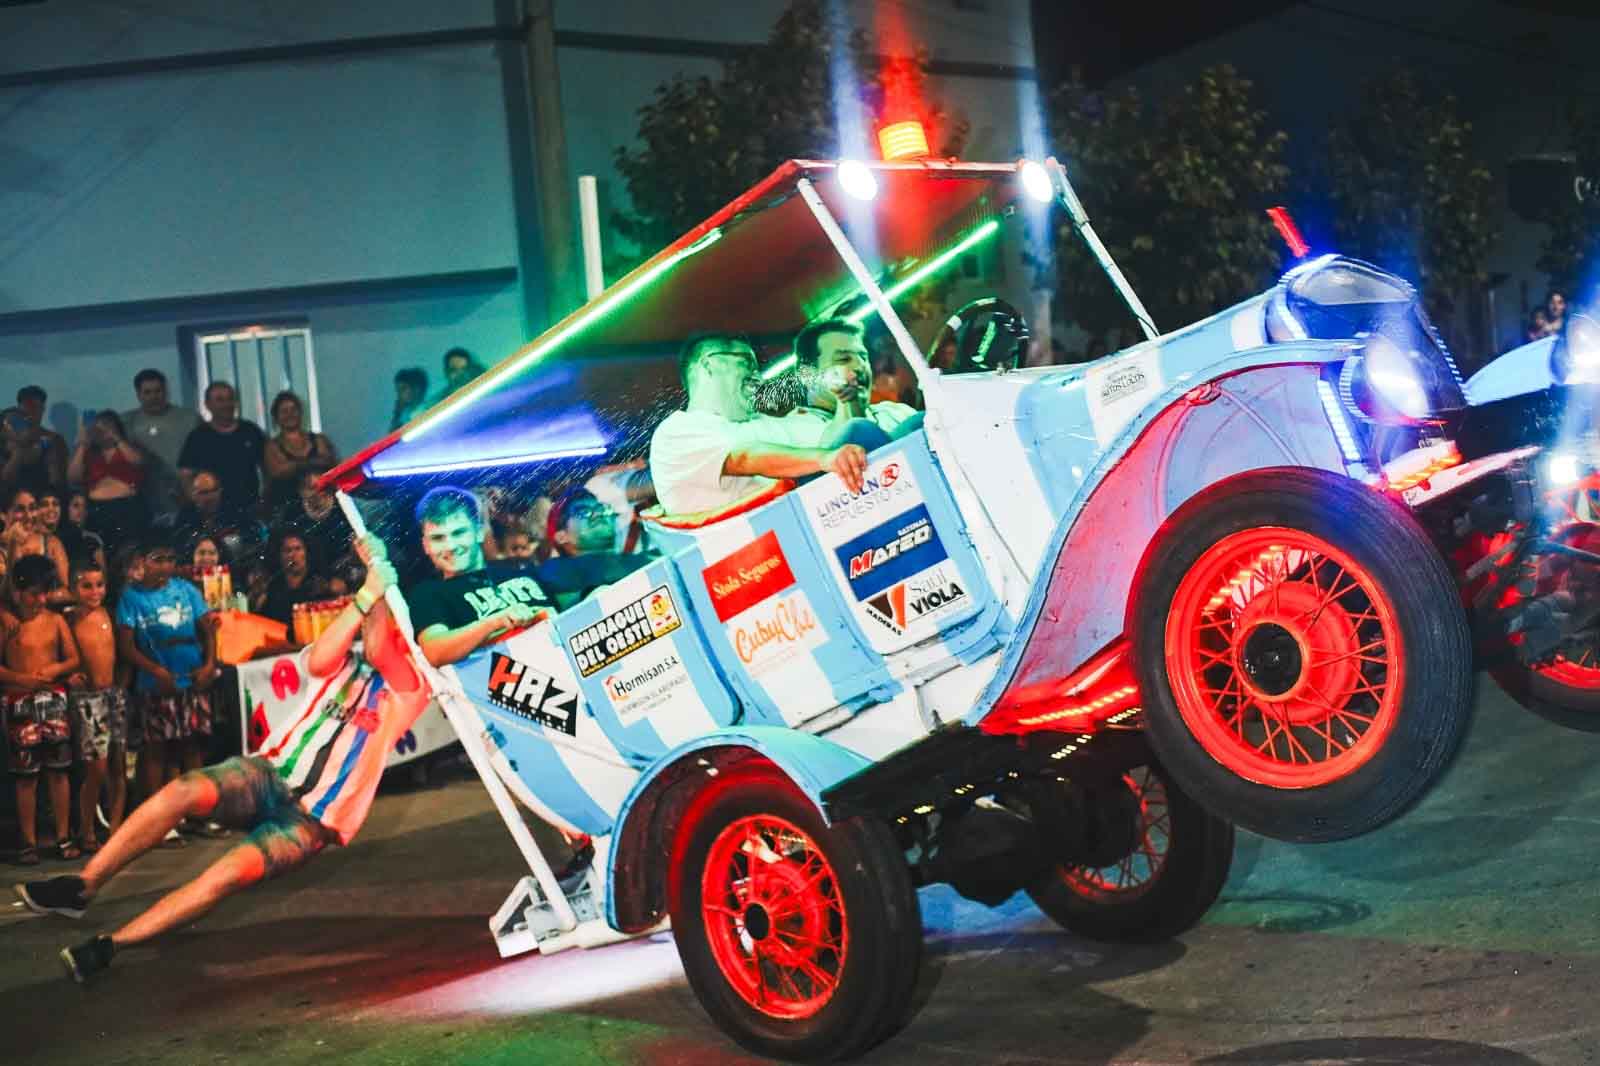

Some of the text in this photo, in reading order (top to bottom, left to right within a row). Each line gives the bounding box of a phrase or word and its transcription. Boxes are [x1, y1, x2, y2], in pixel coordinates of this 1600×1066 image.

[849, 525, 932, 579] MATEO
[909, 582, 965, 614] VIOLA
[576, 645, 606, 670] DEL
[605, 618, 653, 655] OESTE
[488, 654, 578, 722] HAZ
[613, 663, 666, 697] Hormisan
